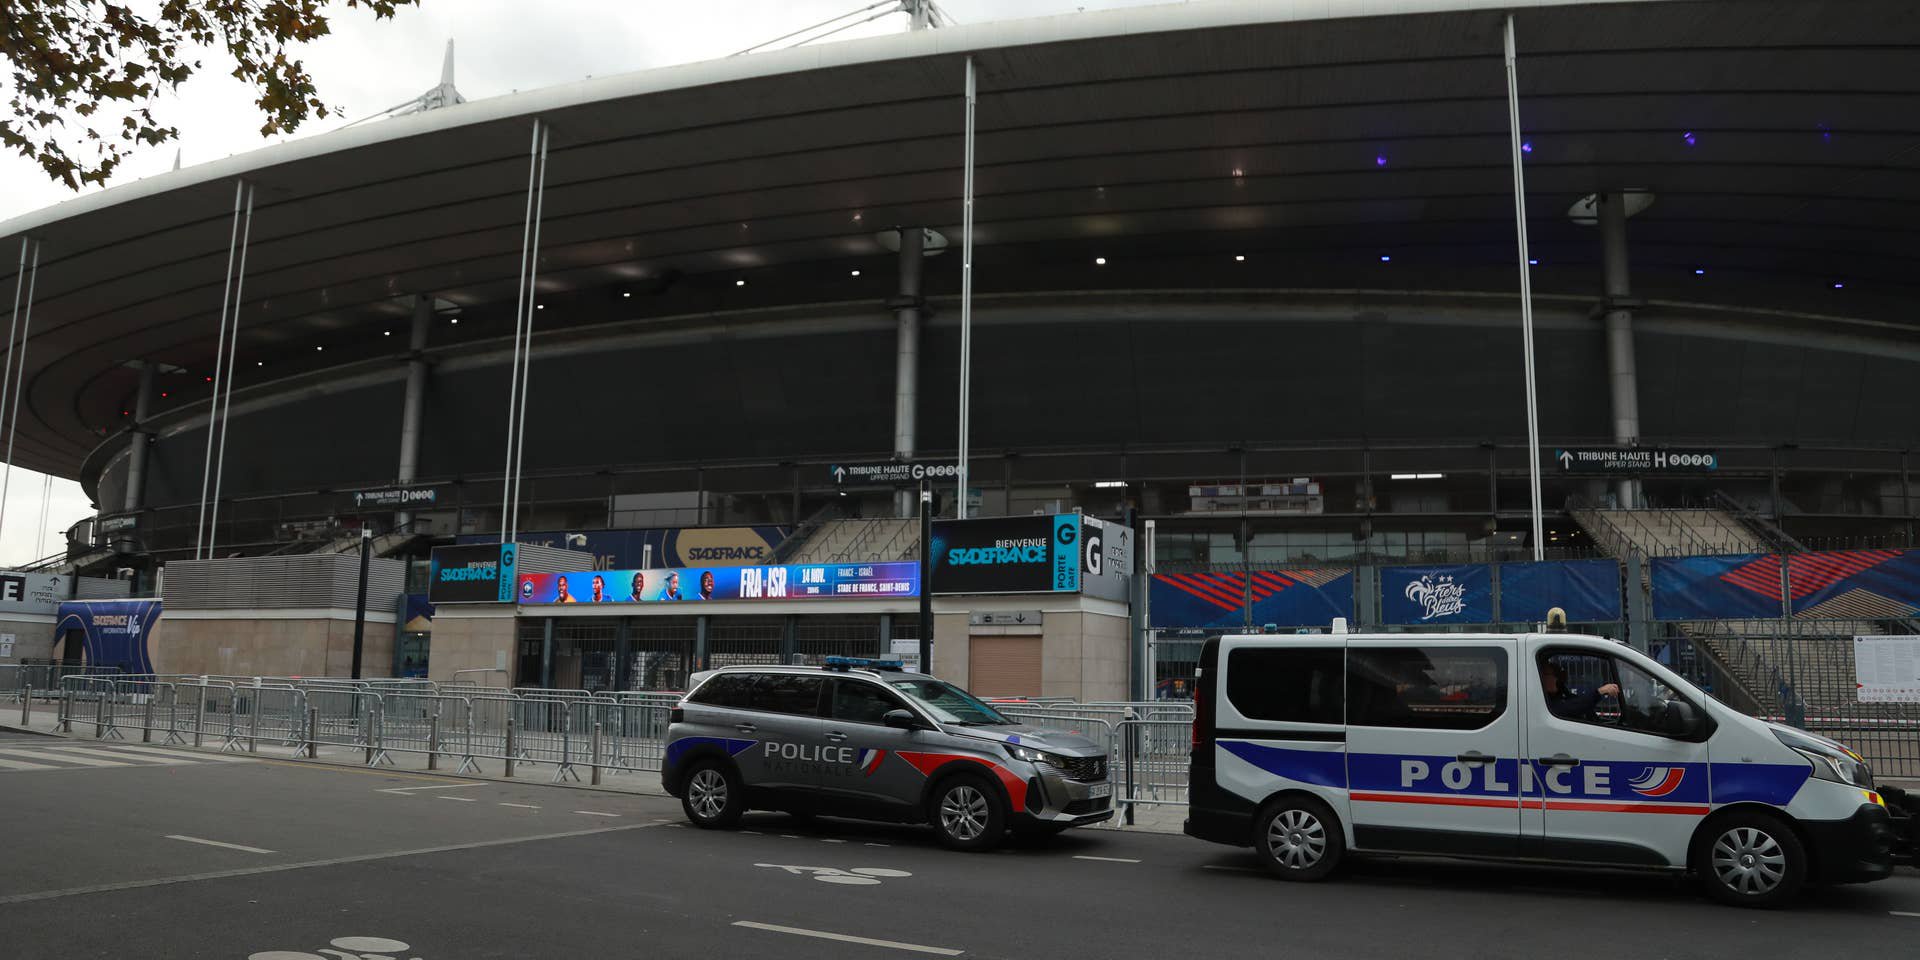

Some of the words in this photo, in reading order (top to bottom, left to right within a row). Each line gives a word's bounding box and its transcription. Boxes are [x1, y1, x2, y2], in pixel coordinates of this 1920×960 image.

[1577, 451, 1617, 461] TRIBUNE
[1619, 451, 1650, 461] HAUTE
[1654, 451, 1666, 468] H
[848, 466, 882, 475] TRIBUNE
[883, 465, 910, 474] HAUTE
[912, 464, 925, 479] G
[870, 473, 889, 481] UPPER
[402, 490, 409, 502] D
[1057, 523, 1076, 545] G
[995, 537, 1047, 549] BIENVENUE
[503, 550, 513, 567] G
[1086, 536, 1101, 576] G
[802, 568, 810, 584] 14
[837, 568, 854, 577] FRANCE
[1057, 554, 1066, 588] PORTE
[3, 581, 19, 601] E
[740, 568, 762, 598] FRA
[767, 567, 787, 597] ISR
[837, 583, 852, 593] STADE
[852, 583, 858, 593] DE
[879, 582, 910, 592] SAINT-DENIS
[1434, 583, 1466, 598] Fiers
[1422, 595, 1466, 620] Bleus
[764, 741, 853, 764] POLICE
[763, 761, 853, 777] NATIONALE
[1400, 759, 1611, 795] POLICE
